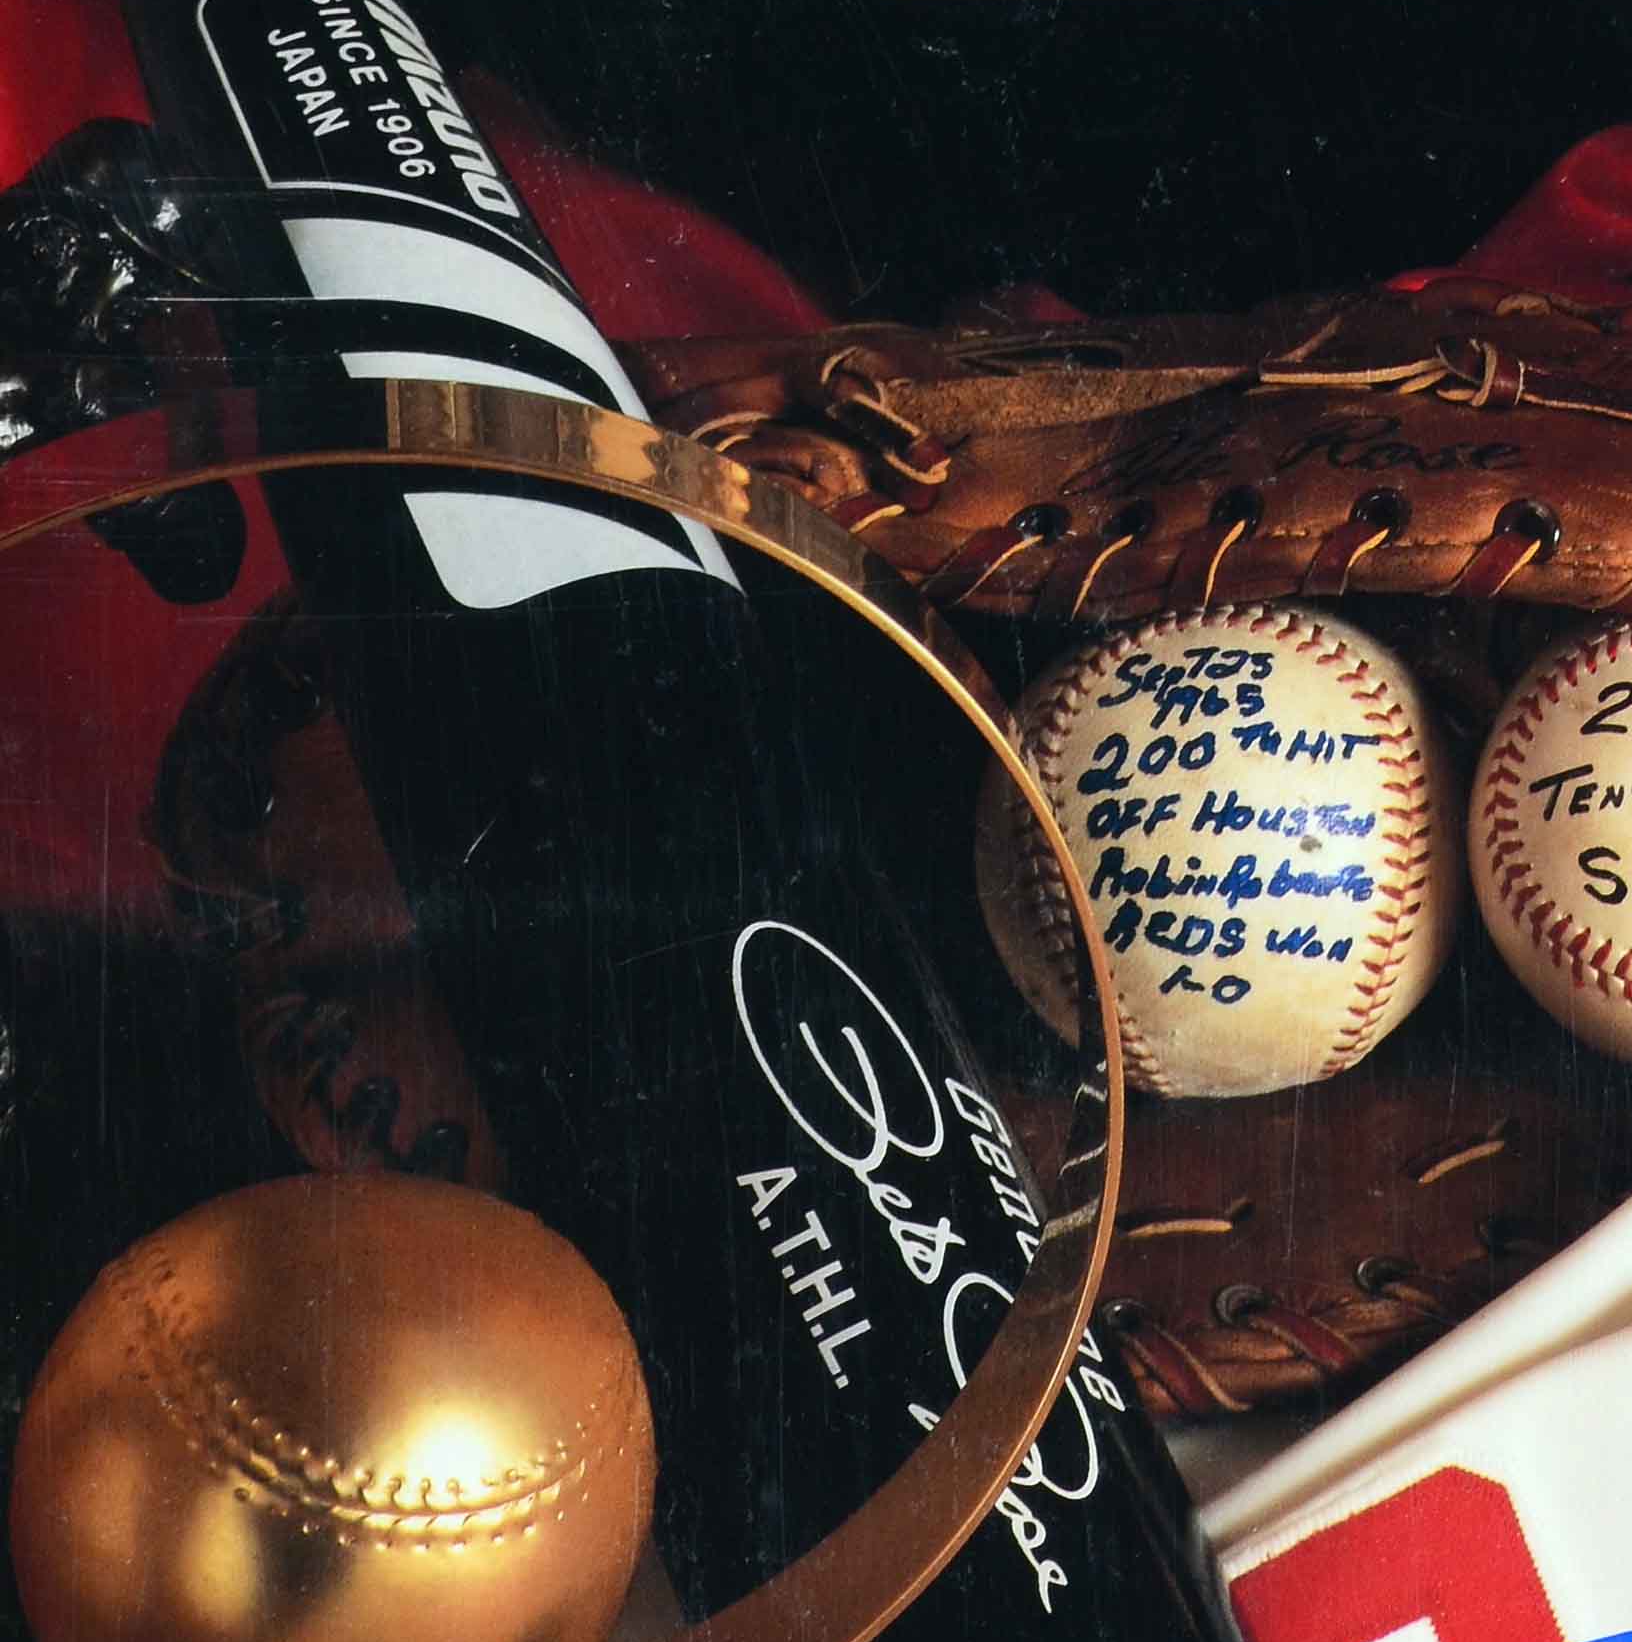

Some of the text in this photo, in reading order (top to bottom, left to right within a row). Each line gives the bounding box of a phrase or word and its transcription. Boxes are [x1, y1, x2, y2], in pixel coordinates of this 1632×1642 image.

[267, 28, 350, 138] JAPAN
[368, 97, 437, 179] 1906
[1285, 728, 1386, 764] HIT
[1085, 793, 1182, 841] OFF
